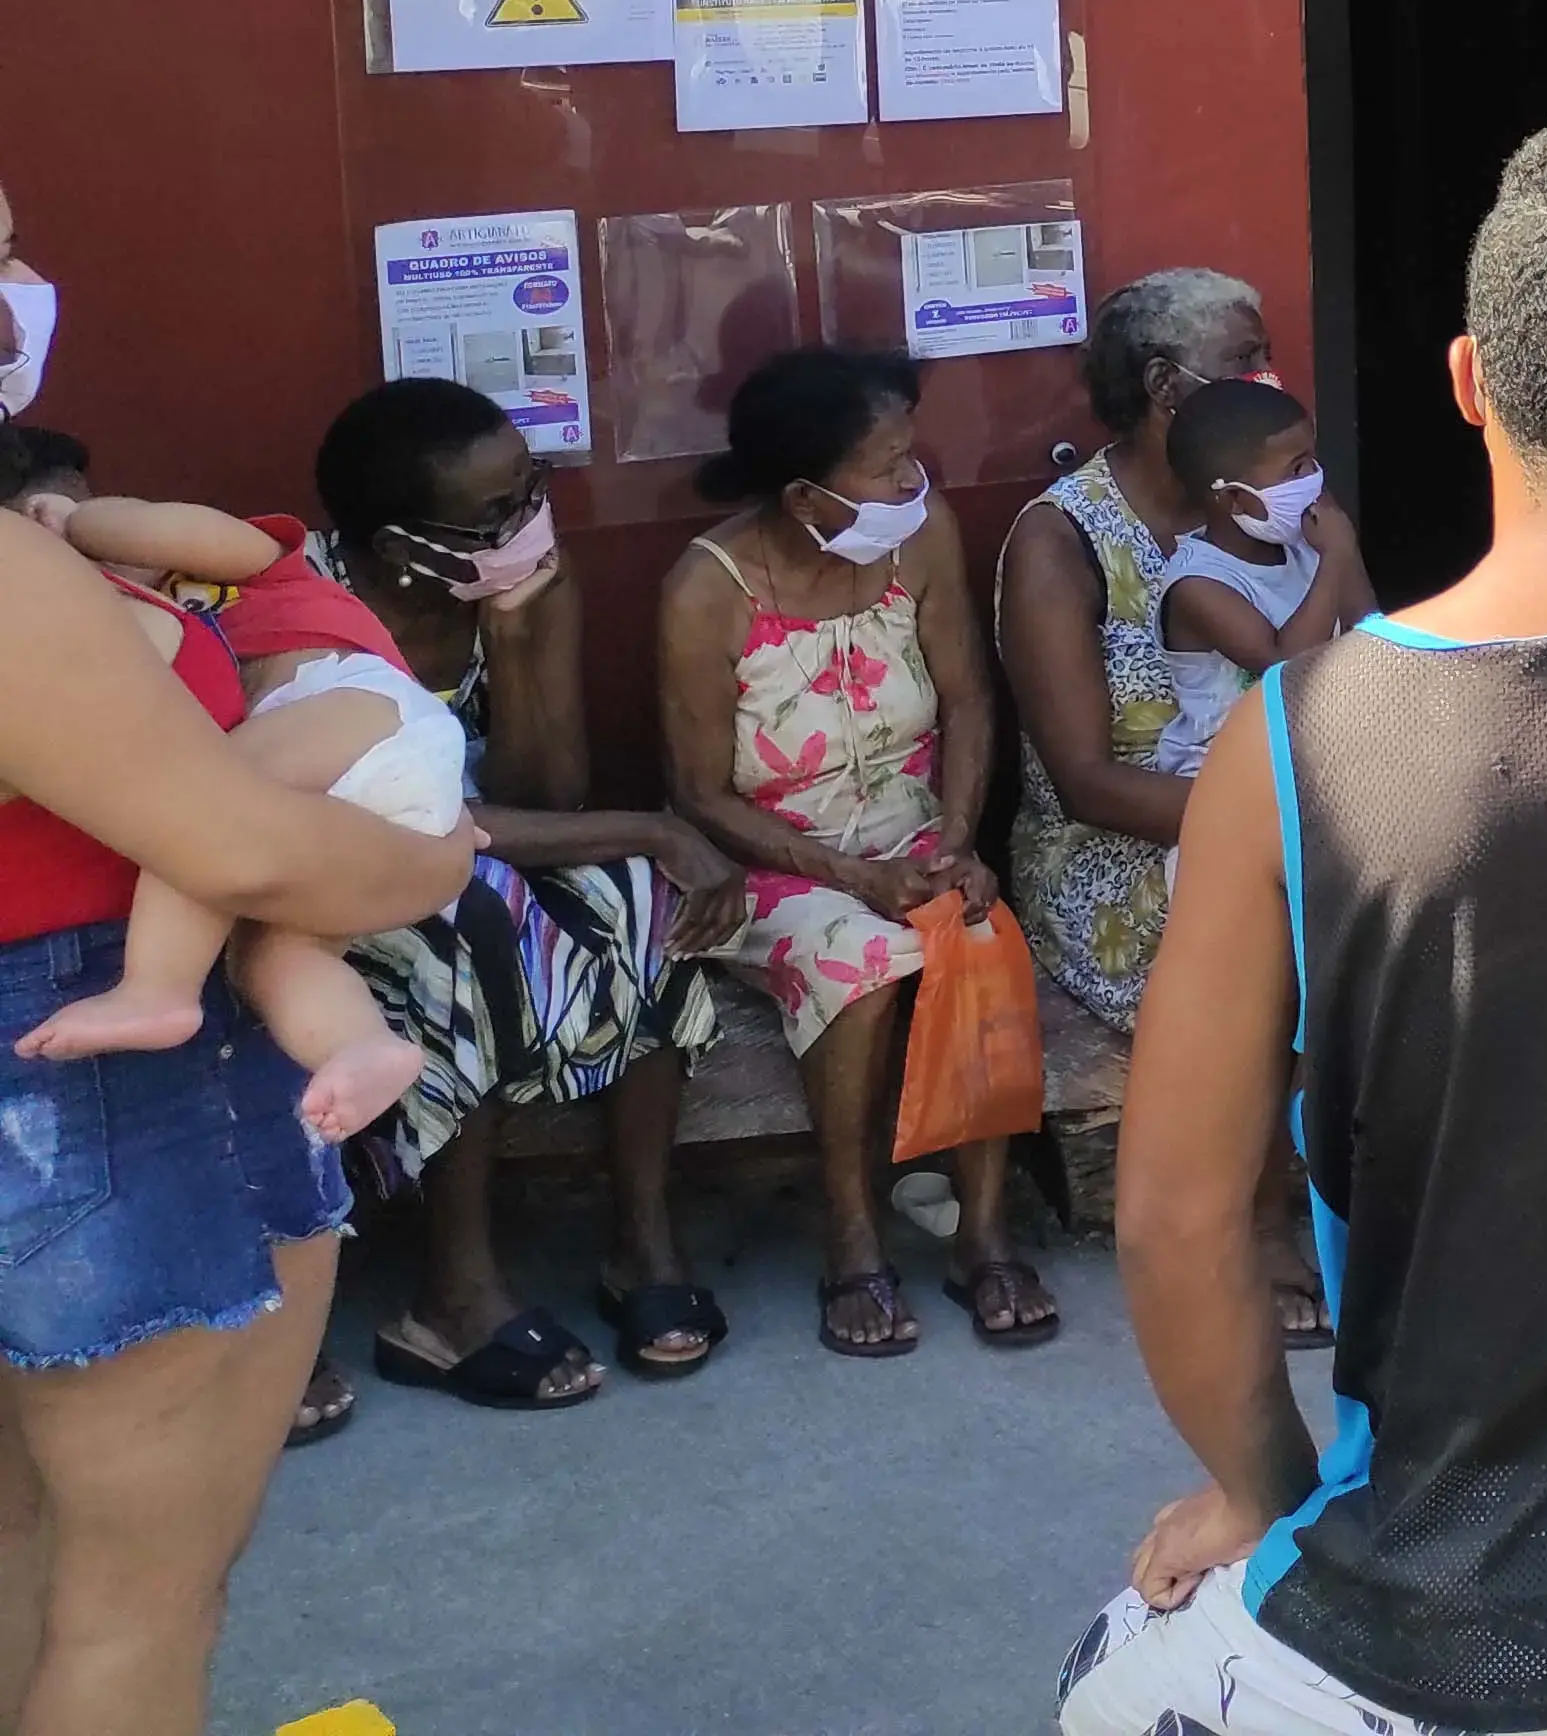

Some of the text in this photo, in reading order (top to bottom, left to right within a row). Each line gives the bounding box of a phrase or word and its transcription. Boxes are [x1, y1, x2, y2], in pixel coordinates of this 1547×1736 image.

[409, 249, 548, 271] QUADRO DE AVISOS
[403, 270, 452, 282] MULTIUSO
[482, 261, 555, 276] TRANSPARENTE
